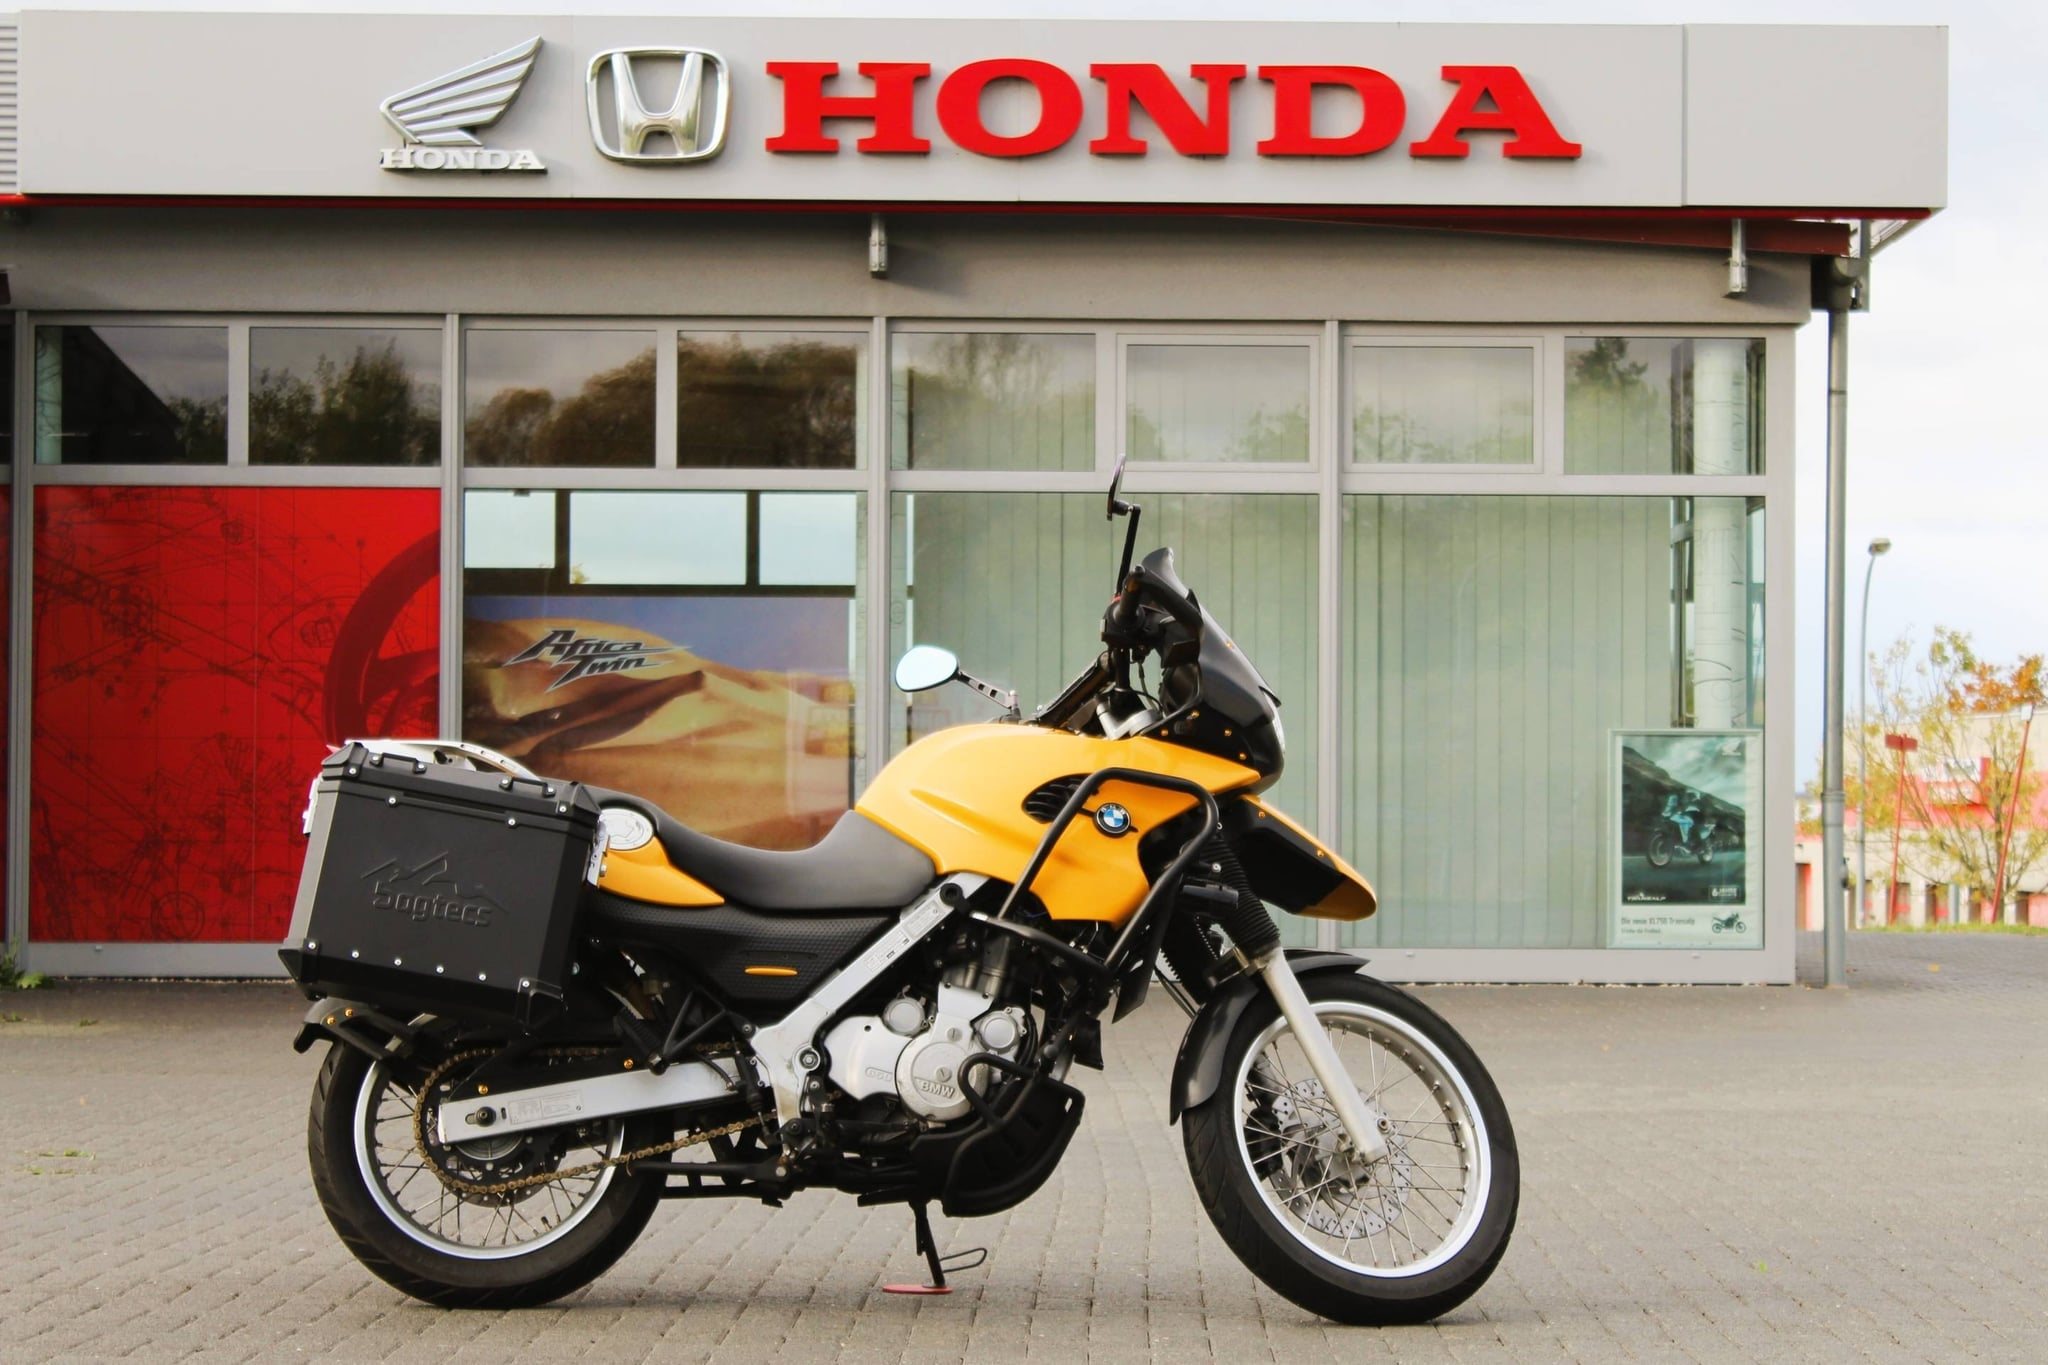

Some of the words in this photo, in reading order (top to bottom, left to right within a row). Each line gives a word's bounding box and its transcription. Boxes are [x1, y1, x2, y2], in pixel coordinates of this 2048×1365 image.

[765, 58, 1583, 159] HONDA
[379, 146, 546, 170] HONDA
[500, 628, 693, 668] Africa
[543, 654, 675, 694] Twin
[918, 1080, 955, 1098] BMW
